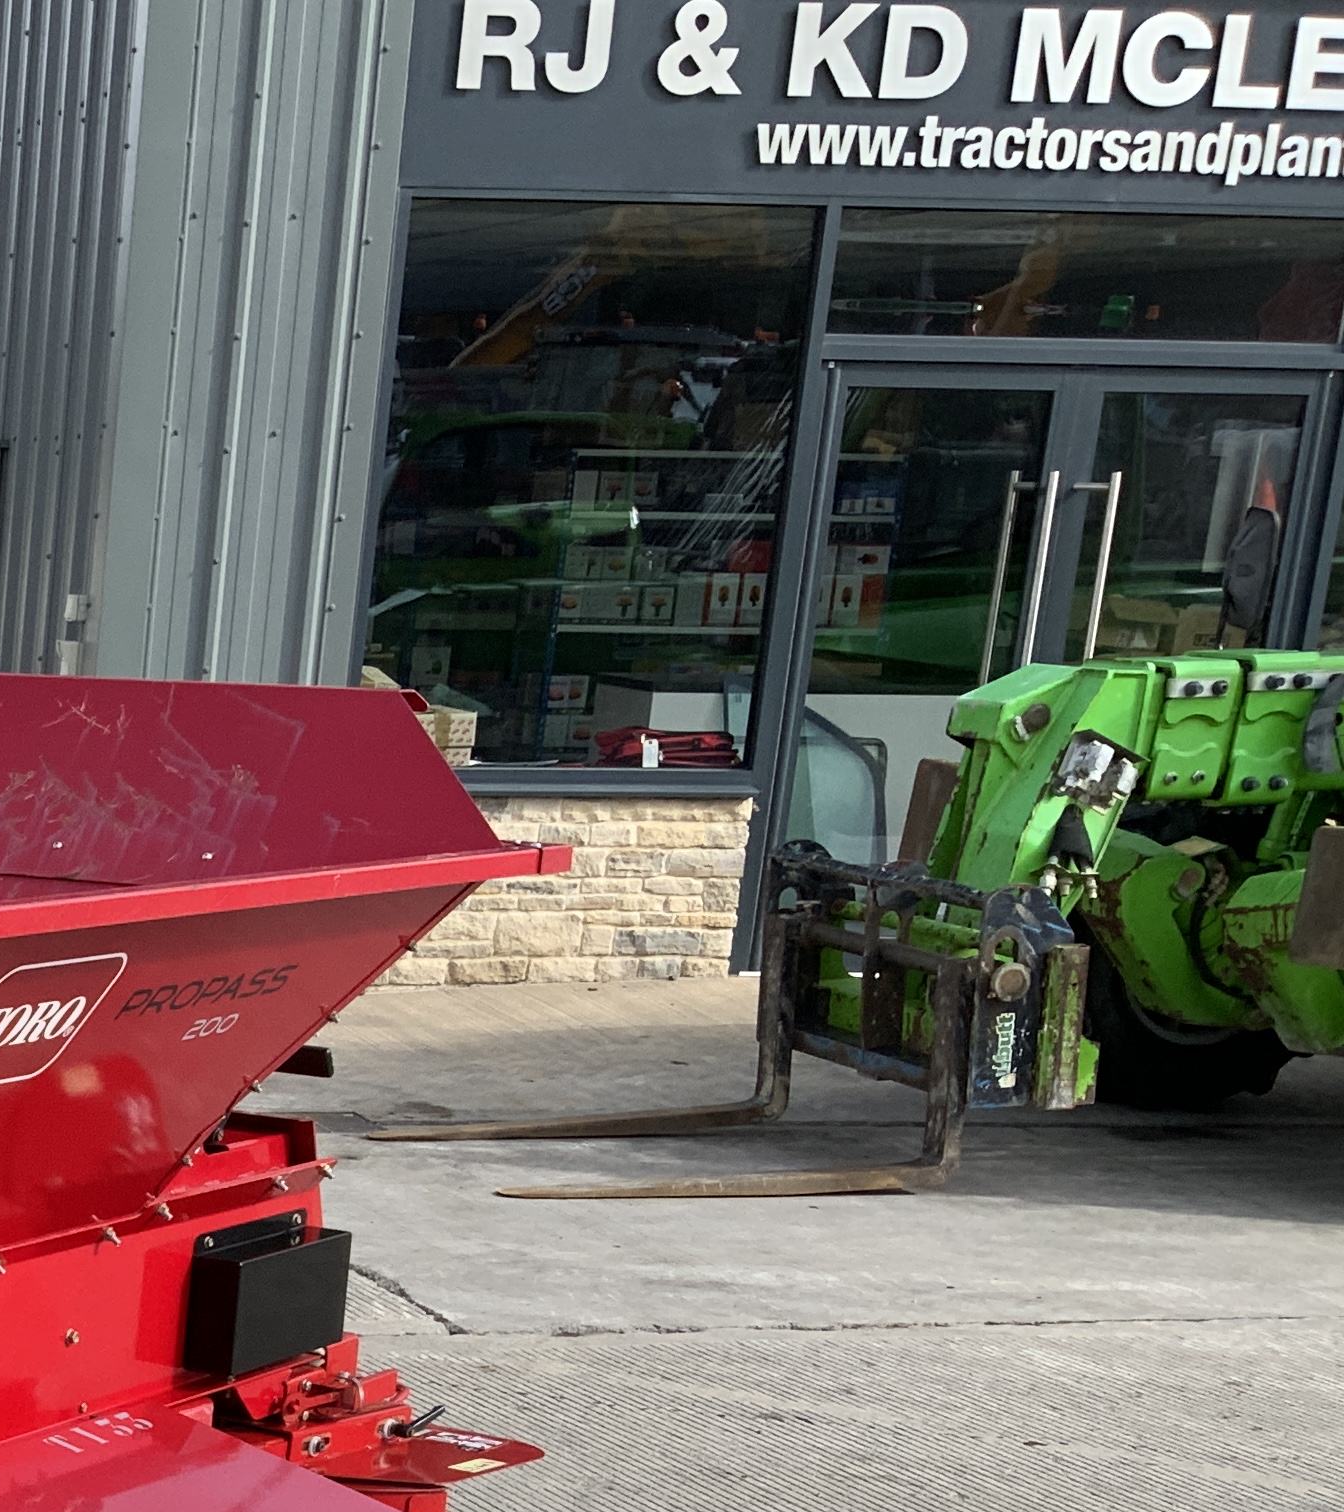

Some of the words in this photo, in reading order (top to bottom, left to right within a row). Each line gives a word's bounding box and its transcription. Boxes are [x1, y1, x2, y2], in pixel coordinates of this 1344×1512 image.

[455, 0, 614, 94] RJ
[656, 0, 743, 97] &
[786, 1, 969, 101] KD
[1009, 7, 1344, 112] MCLE
[756, 115, 1344, 187] www.tractorsandplan
[113, 964, 299, 1021] PROPASS
[180, 1012, 240, 1042] 200
